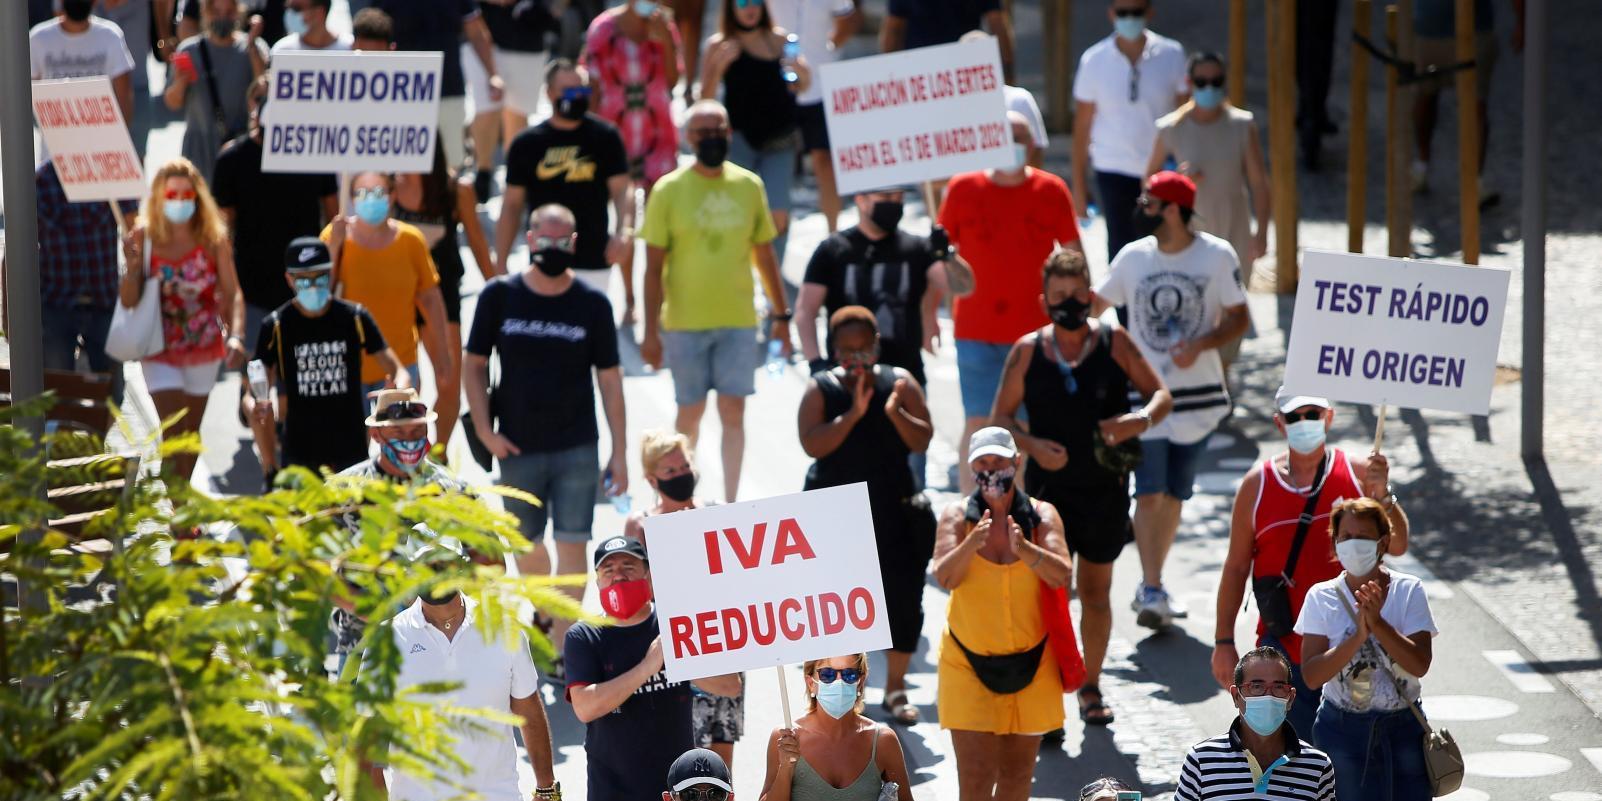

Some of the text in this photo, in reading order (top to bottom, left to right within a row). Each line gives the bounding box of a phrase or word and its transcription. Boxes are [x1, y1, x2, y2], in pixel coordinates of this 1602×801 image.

[276, 71, 435, 101] BENIDORM
[832, 64, 997, 115] AMPLIACIÓN DE LOS ERTES
[271, 125, 429, 155] DESTINO SEGURO
[838, 122, 1007, 171] HASTA EL 15 DE MARZO 2021
[1314, 280, 1489, 327] TEST RÁPIDO
[297, 355, 345, 370] SEOUL
[1317, 344, 1466, 388] EN ORIGEN
[298, 382, 347, 396] MILAN
[703, 518, 817, 575] IVA
[668, 586, 876, 659] REDUCIDO
